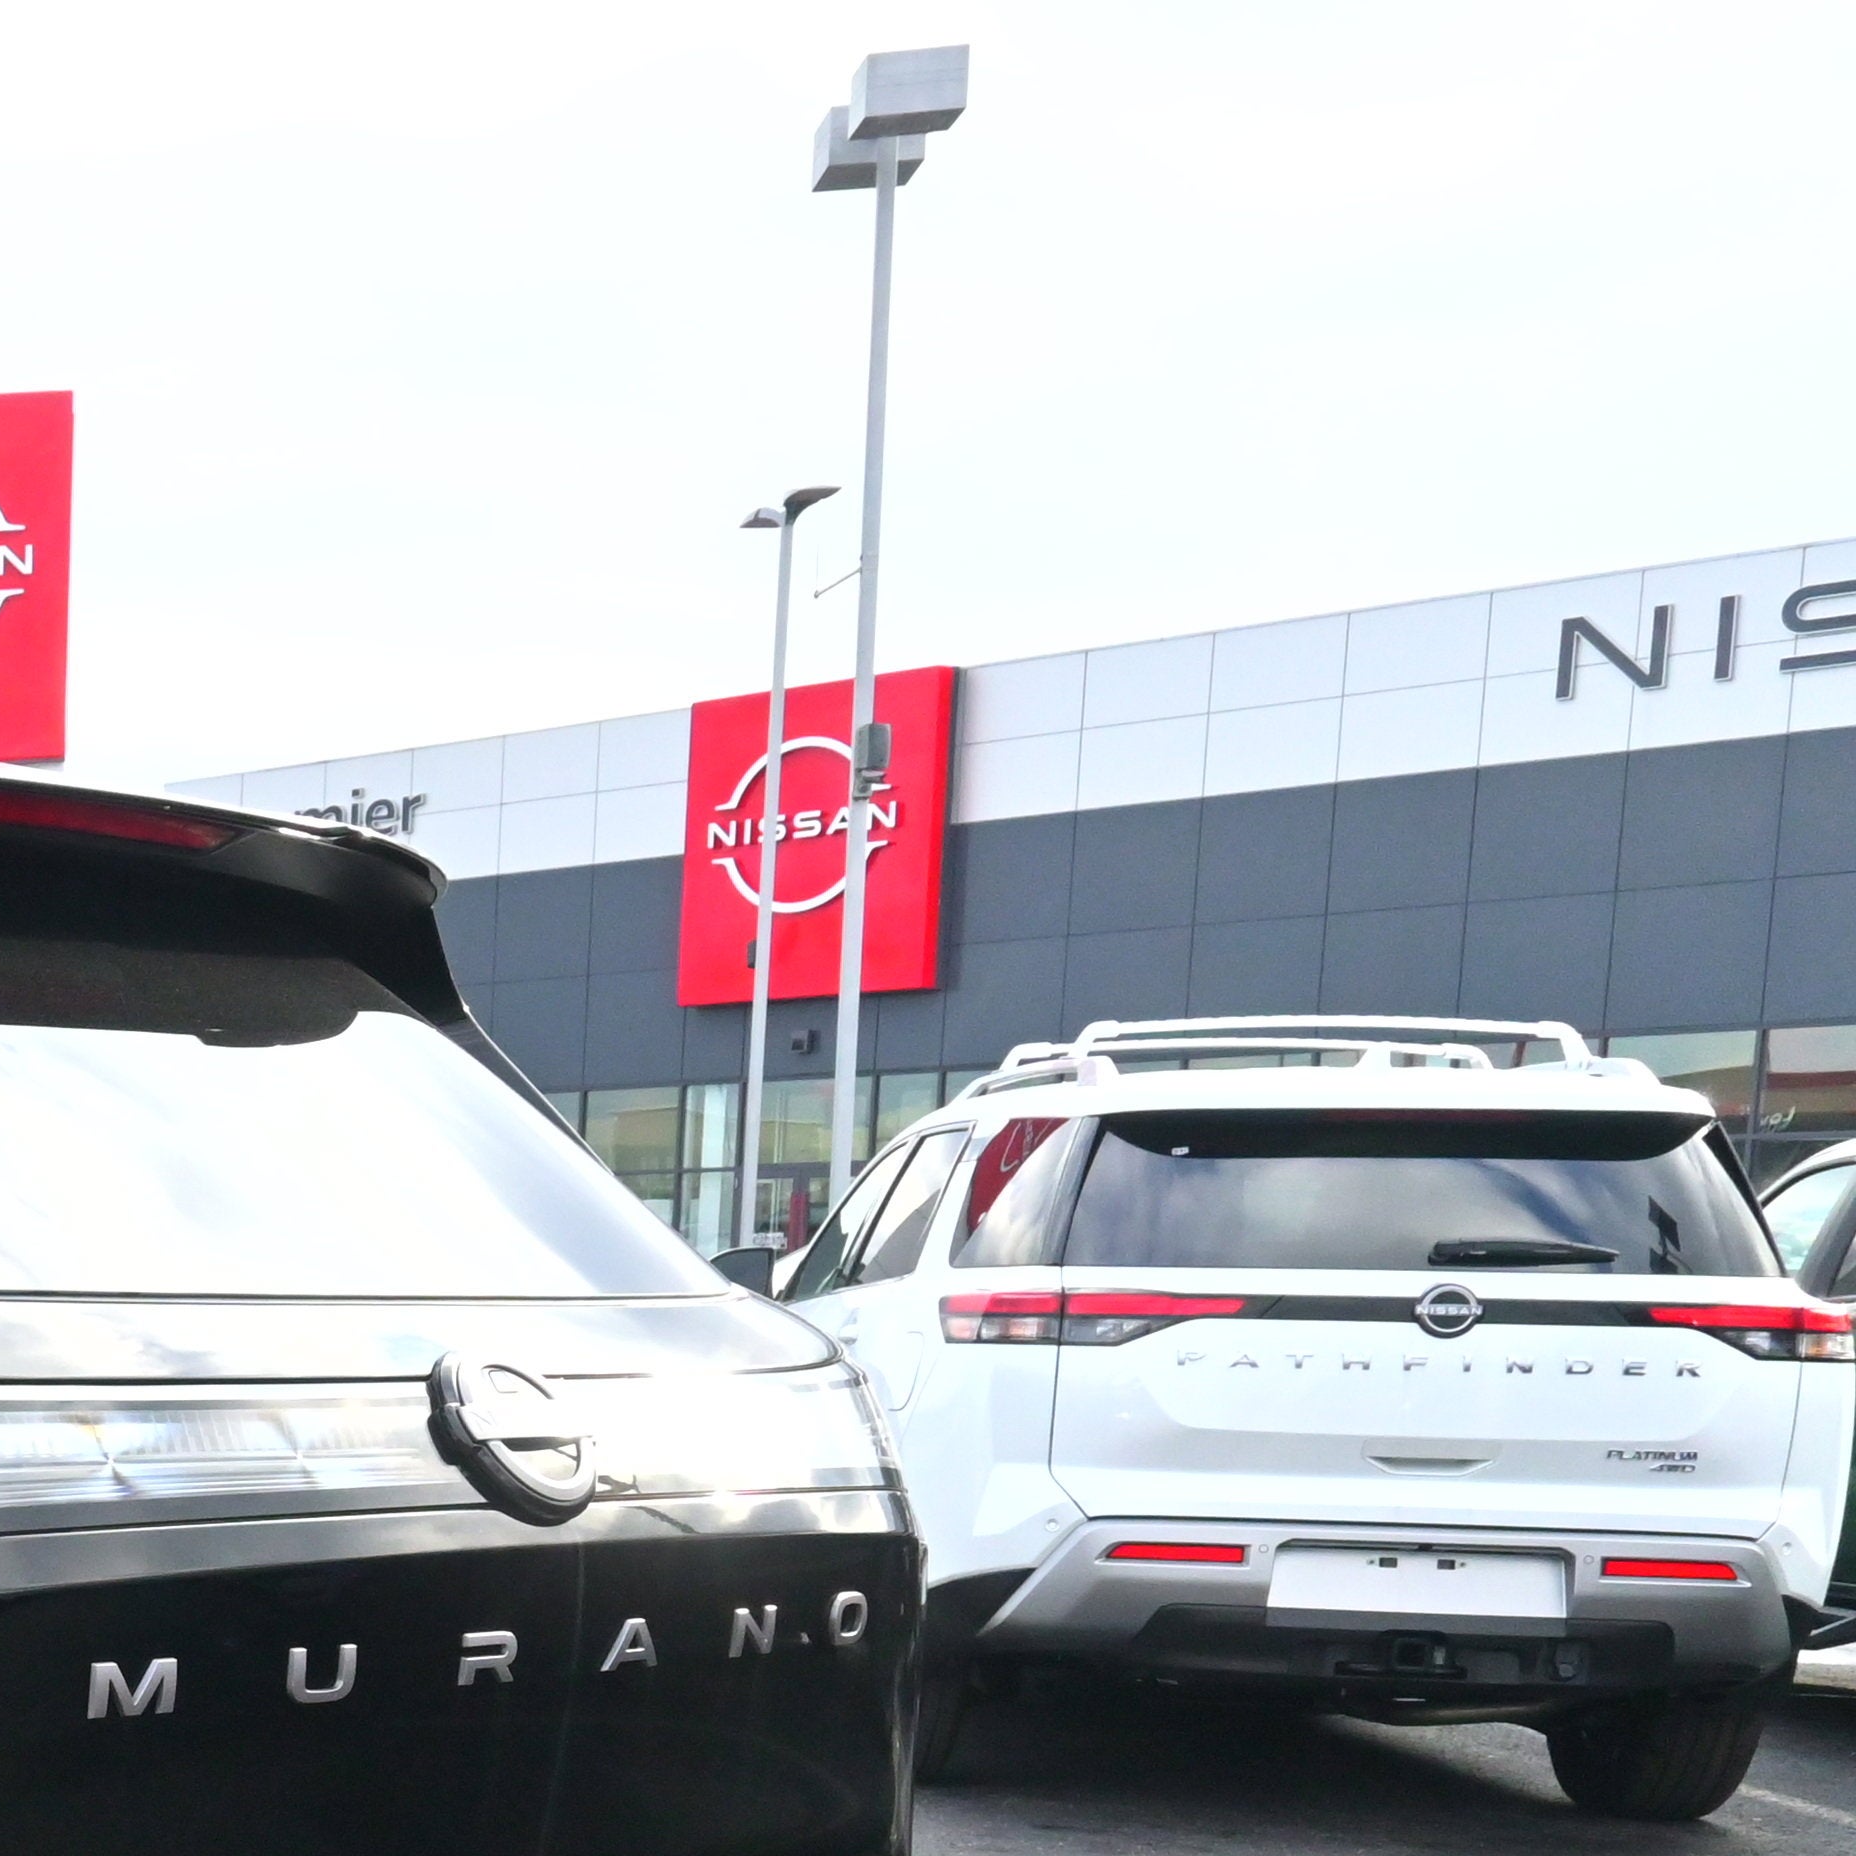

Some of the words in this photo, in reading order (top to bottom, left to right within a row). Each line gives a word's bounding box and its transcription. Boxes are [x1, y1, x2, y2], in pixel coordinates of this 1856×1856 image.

[1555, 579, 1856, 701] NIS
[1415, 1304, 1483, 1316] NISSAN
[1176, 1350, 1702, 1378] PATHFINDER
[1607, 1449, 1698, 1461] PLATINUM
[1649, 1463, 1696, 1473] 4WD
[87, 1590, 869, 1719] MURANO
